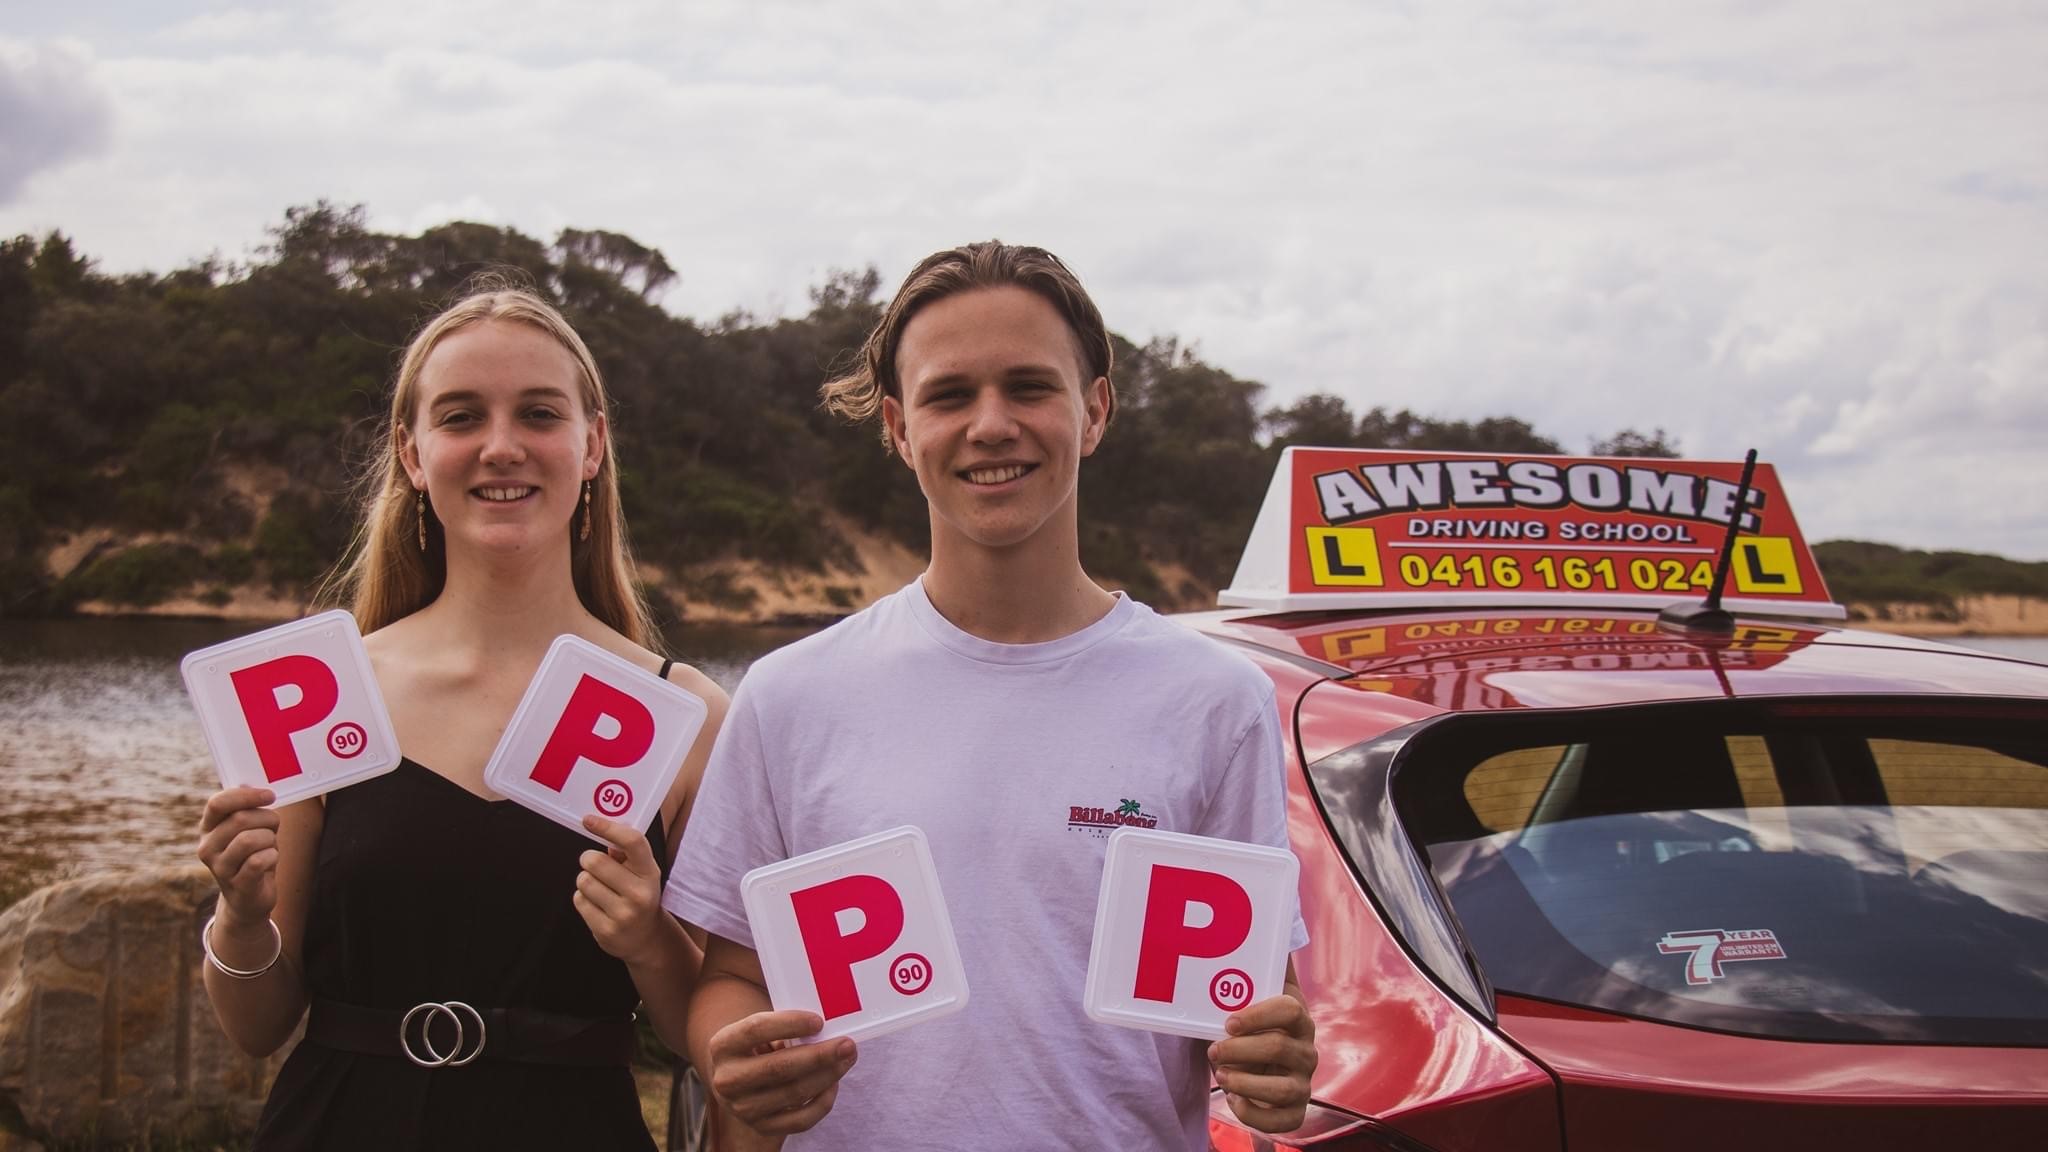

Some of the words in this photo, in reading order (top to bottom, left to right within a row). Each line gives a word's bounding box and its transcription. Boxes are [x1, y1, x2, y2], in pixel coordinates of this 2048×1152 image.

[1314, 461, 1763, 533] AWESOME
[1407, 518, 1547, 538] DRIVING
[1559, 521, 1696, 543] SCHOOL
[1323, 536, 1365, 576] L
[1400, 554, 1523, 588] 0416
[1533, 556, 1618, 590] 161
[1629, 558, 1717, 592] 024
[1744, 545, 1786, 584] L
[230, 655, 339, 784] P
[529, 673, 655, 793] P
[335, 731, 360, 750] 90
[601, 788, 625, 808] 90
[1069, 806, 1158, 829] Billabong
[790, 874, 904, 1021] P
[1133, 864, 1252, 1004] P
[1722, 948, 1780, 957] WARRANTY
[898, 964, 924, 985] 90
[1657, 931, 1724, 984] 7
[1726, 930, 1773, 940] YEAR
[1219, 980, 1245, 1000] 90
